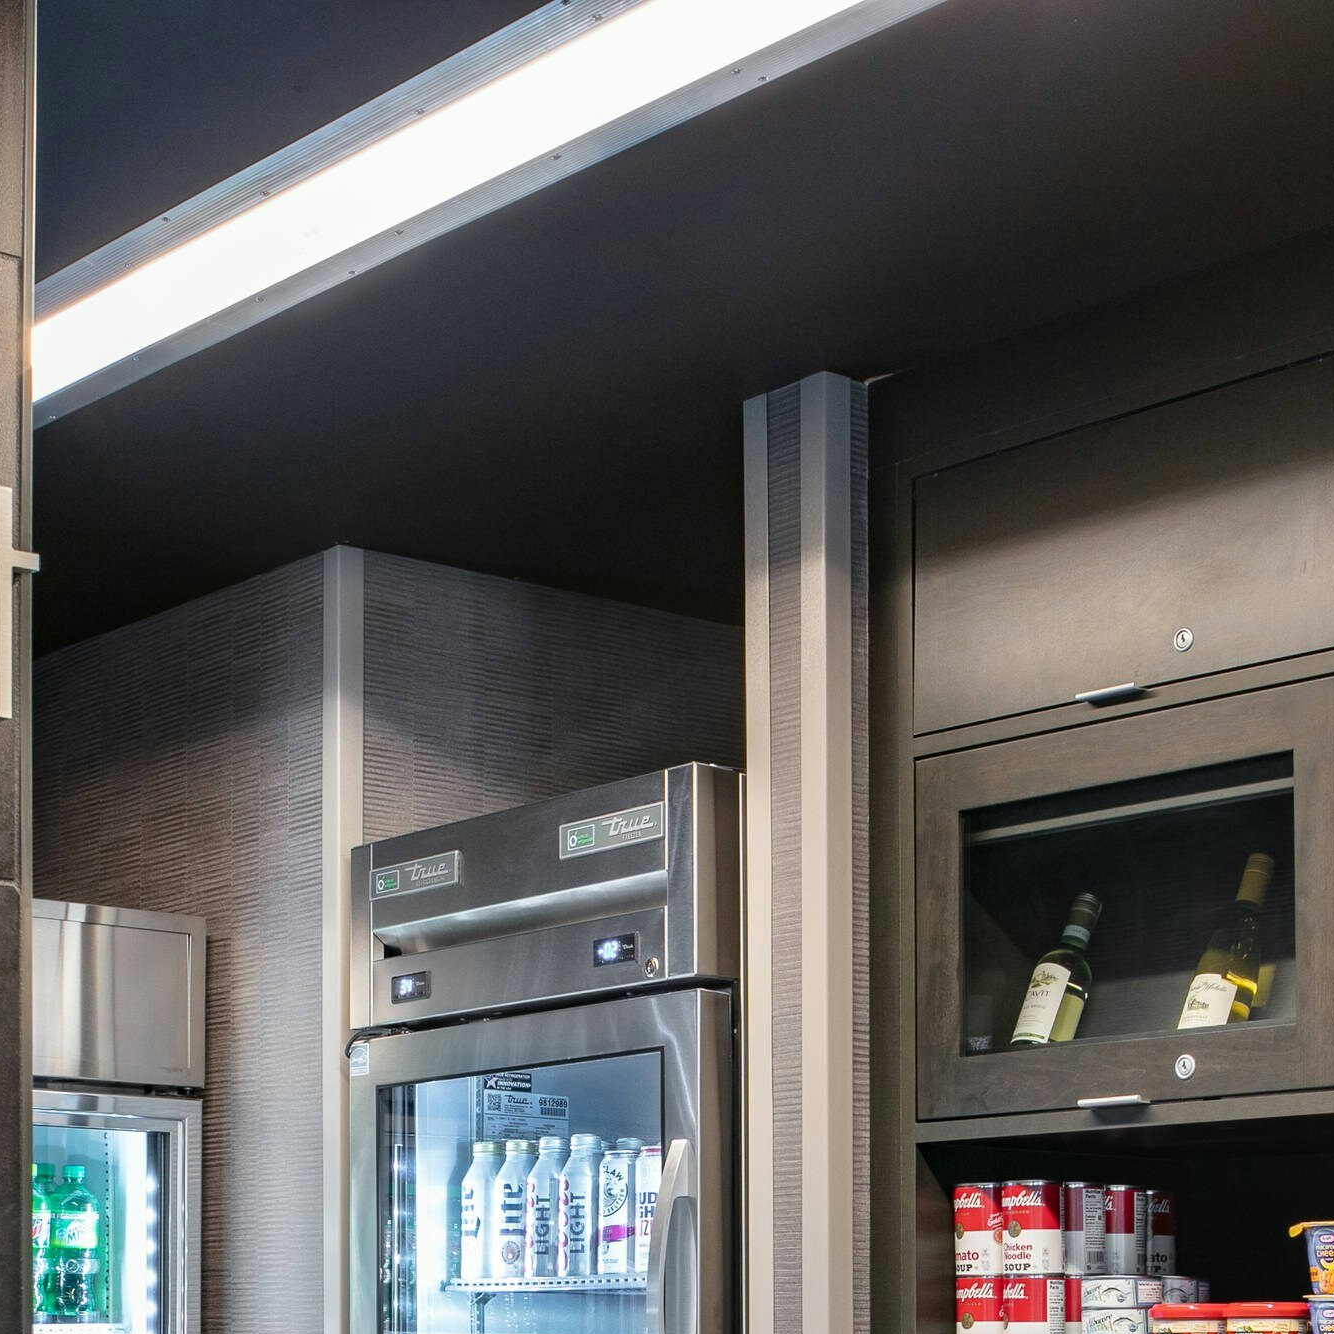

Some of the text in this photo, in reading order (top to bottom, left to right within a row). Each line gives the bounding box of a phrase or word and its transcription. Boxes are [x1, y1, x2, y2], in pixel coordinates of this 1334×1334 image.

[535, 1196, 551, 1256] LIGHT
[570, 1192, 586, 1254] LIGHT
[956, 1264, 973, 1272] OUP
[1004, 1263, 1032, 1272] SOUP
